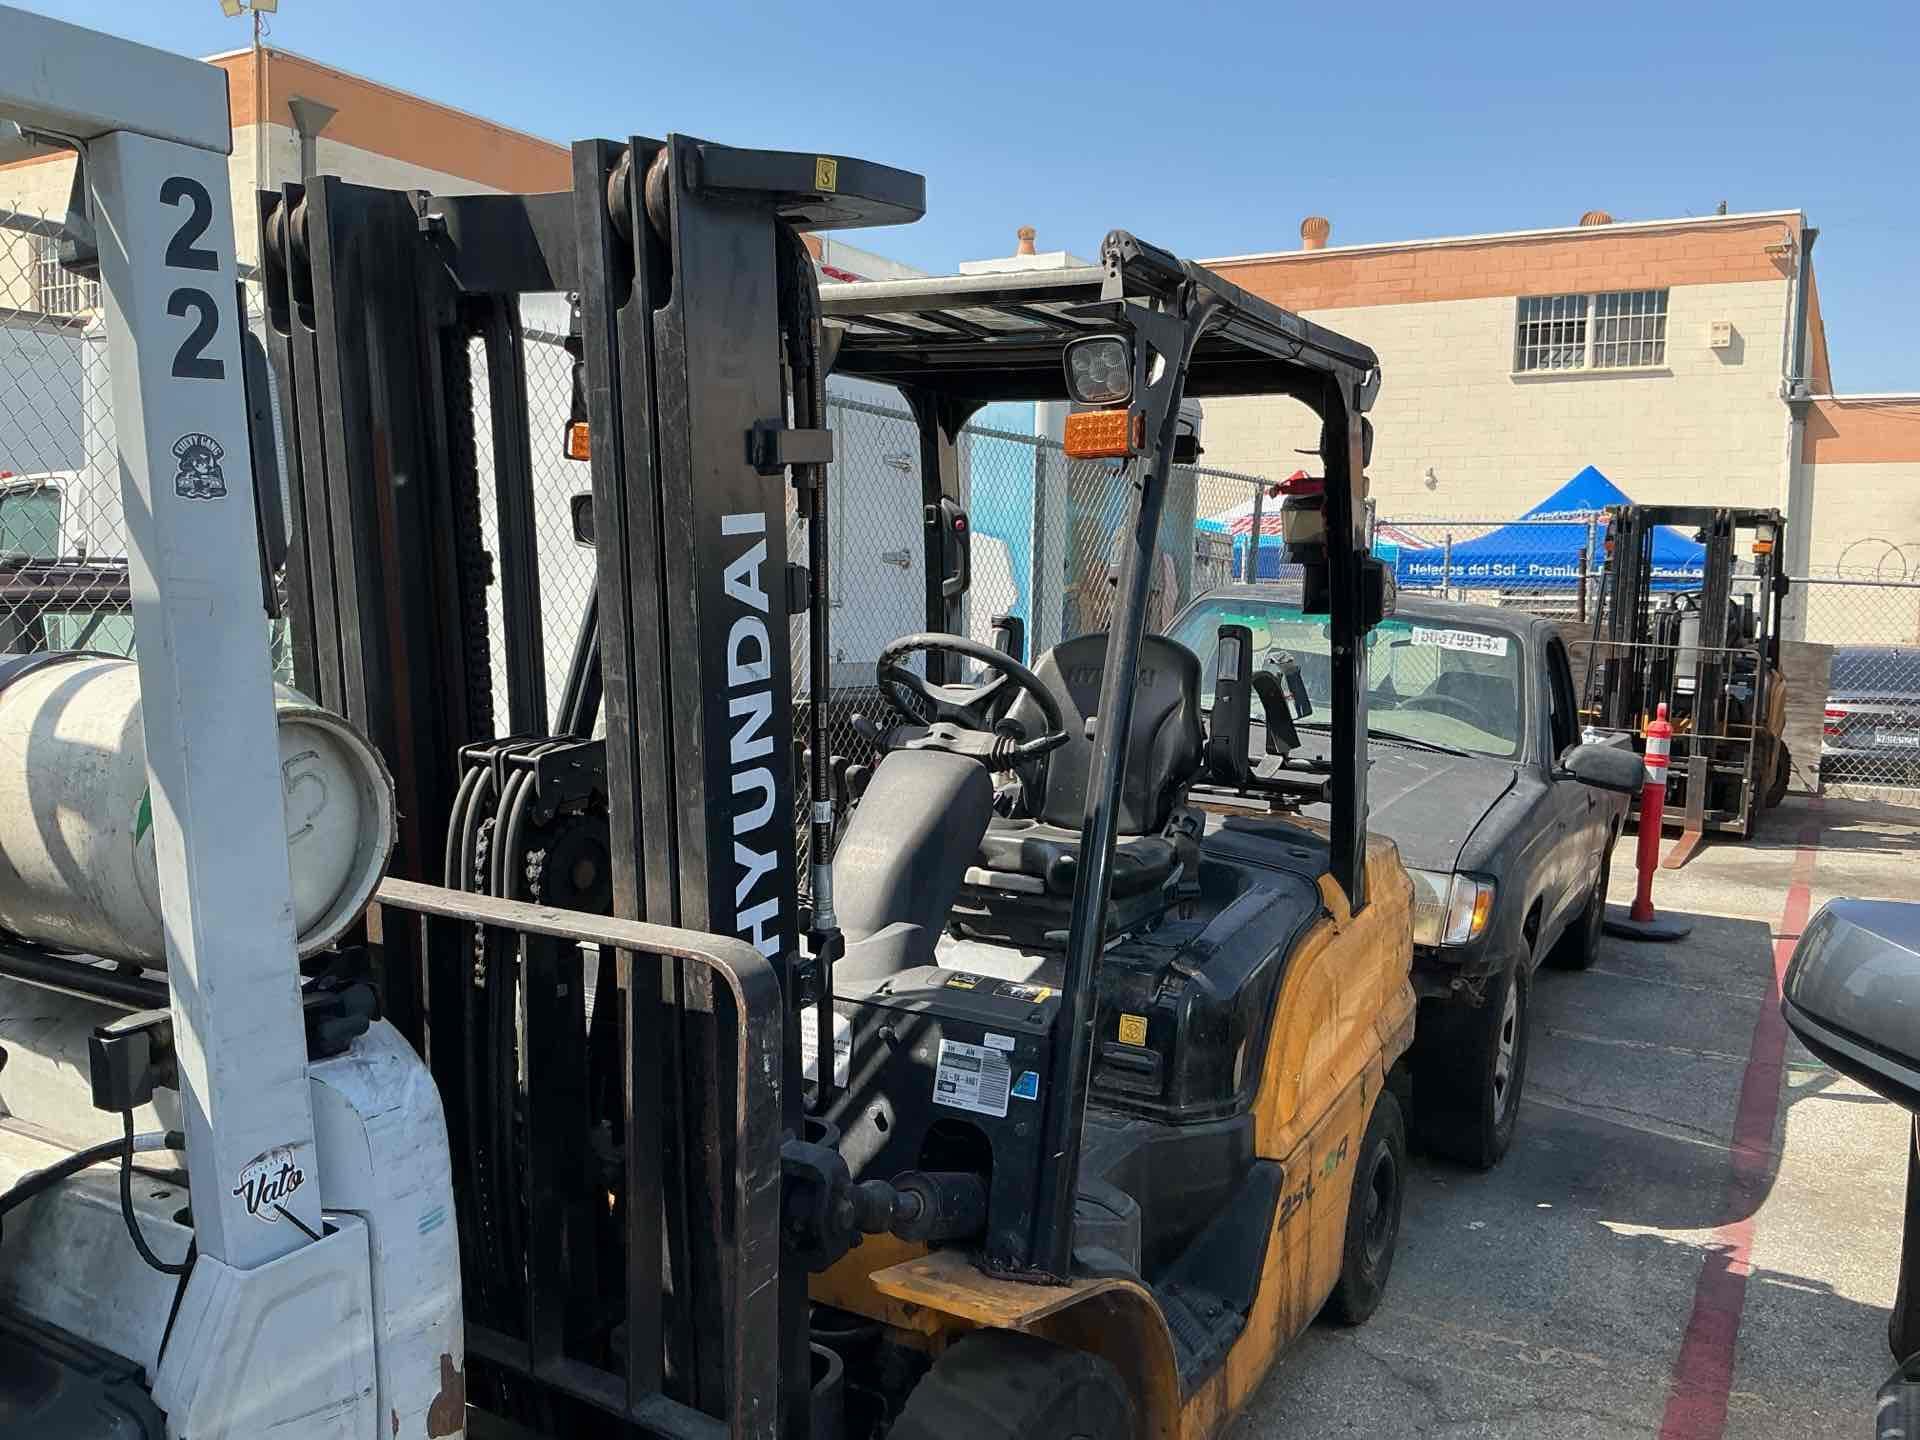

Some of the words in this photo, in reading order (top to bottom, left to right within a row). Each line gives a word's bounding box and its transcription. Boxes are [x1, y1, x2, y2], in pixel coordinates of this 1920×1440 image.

[1467, 563, 1490, 577] del
[1493, 563, 1517, 577] Sol
[1529, 564, 1582, 577] Premiu
[721, 511, 781, 958] HYUNDAI
[233, 1163, 305, 1214] Vato
